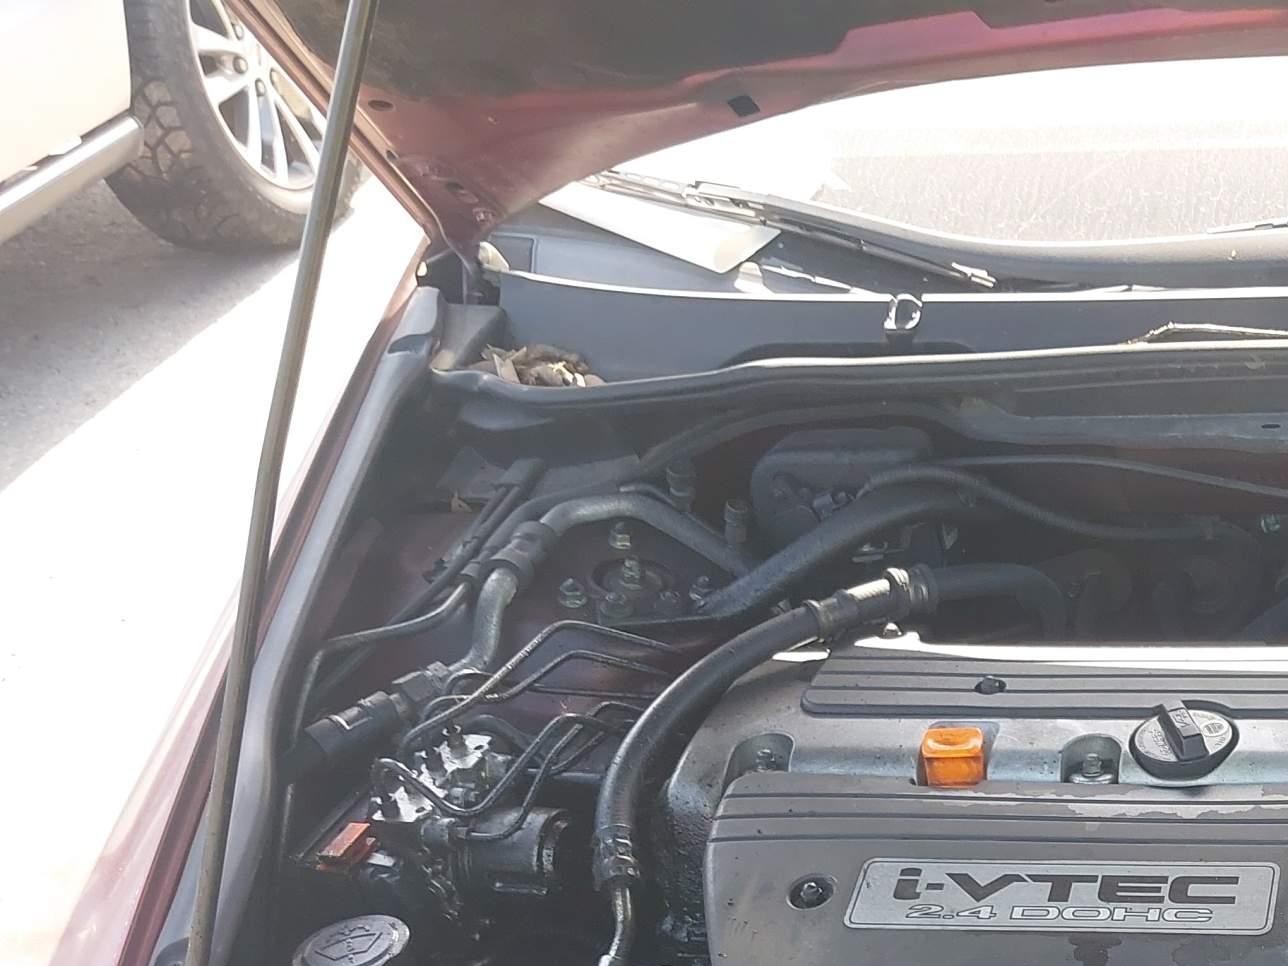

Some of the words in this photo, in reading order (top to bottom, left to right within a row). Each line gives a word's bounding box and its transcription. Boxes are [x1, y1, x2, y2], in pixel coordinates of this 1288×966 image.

[893, 867, 1240, 904] i-VTEC
[906, 905, 997, 920] 2.4
[1010, 906, 1213, 922] DOHC
